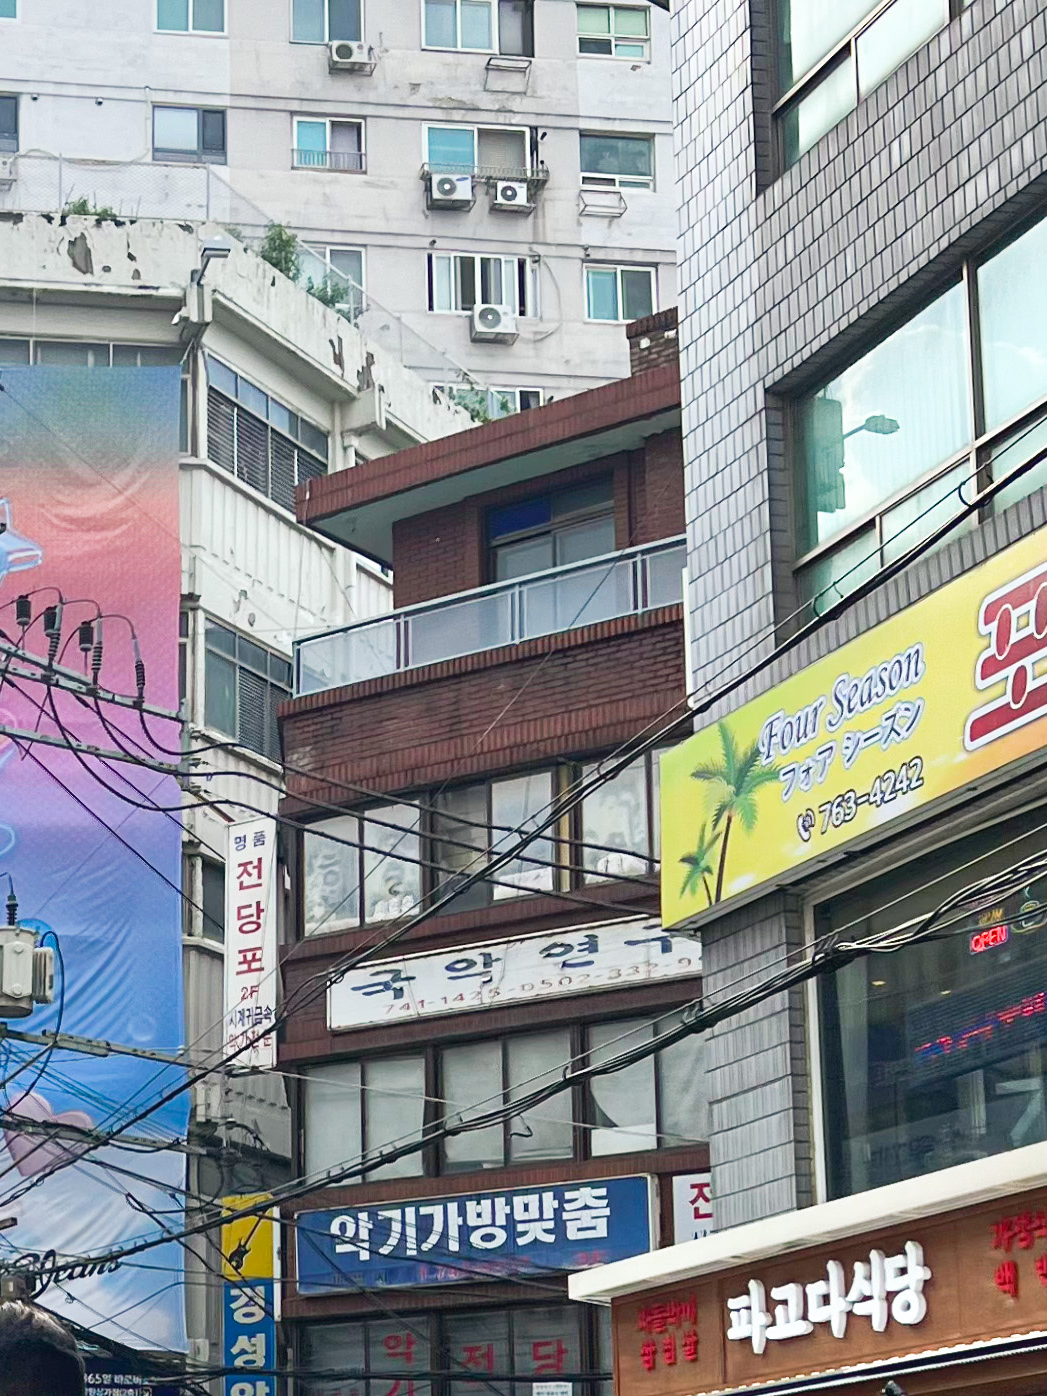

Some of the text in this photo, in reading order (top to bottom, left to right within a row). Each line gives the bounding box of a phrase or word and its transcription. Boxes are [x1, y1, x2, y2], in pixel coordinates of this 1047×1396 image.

[759, 642, 926, 766] Four Season
[818, 755, 925, 835] 763-4242
[234, 830, 267, 852] 명품
[236, 857, 265, 976] 전당포
[971, 925, 1008, 952] OPEN
[329, 1186, 611, 1262] 악기가방맞춤
[727, 1241, 932, 1354] 파고다식당
